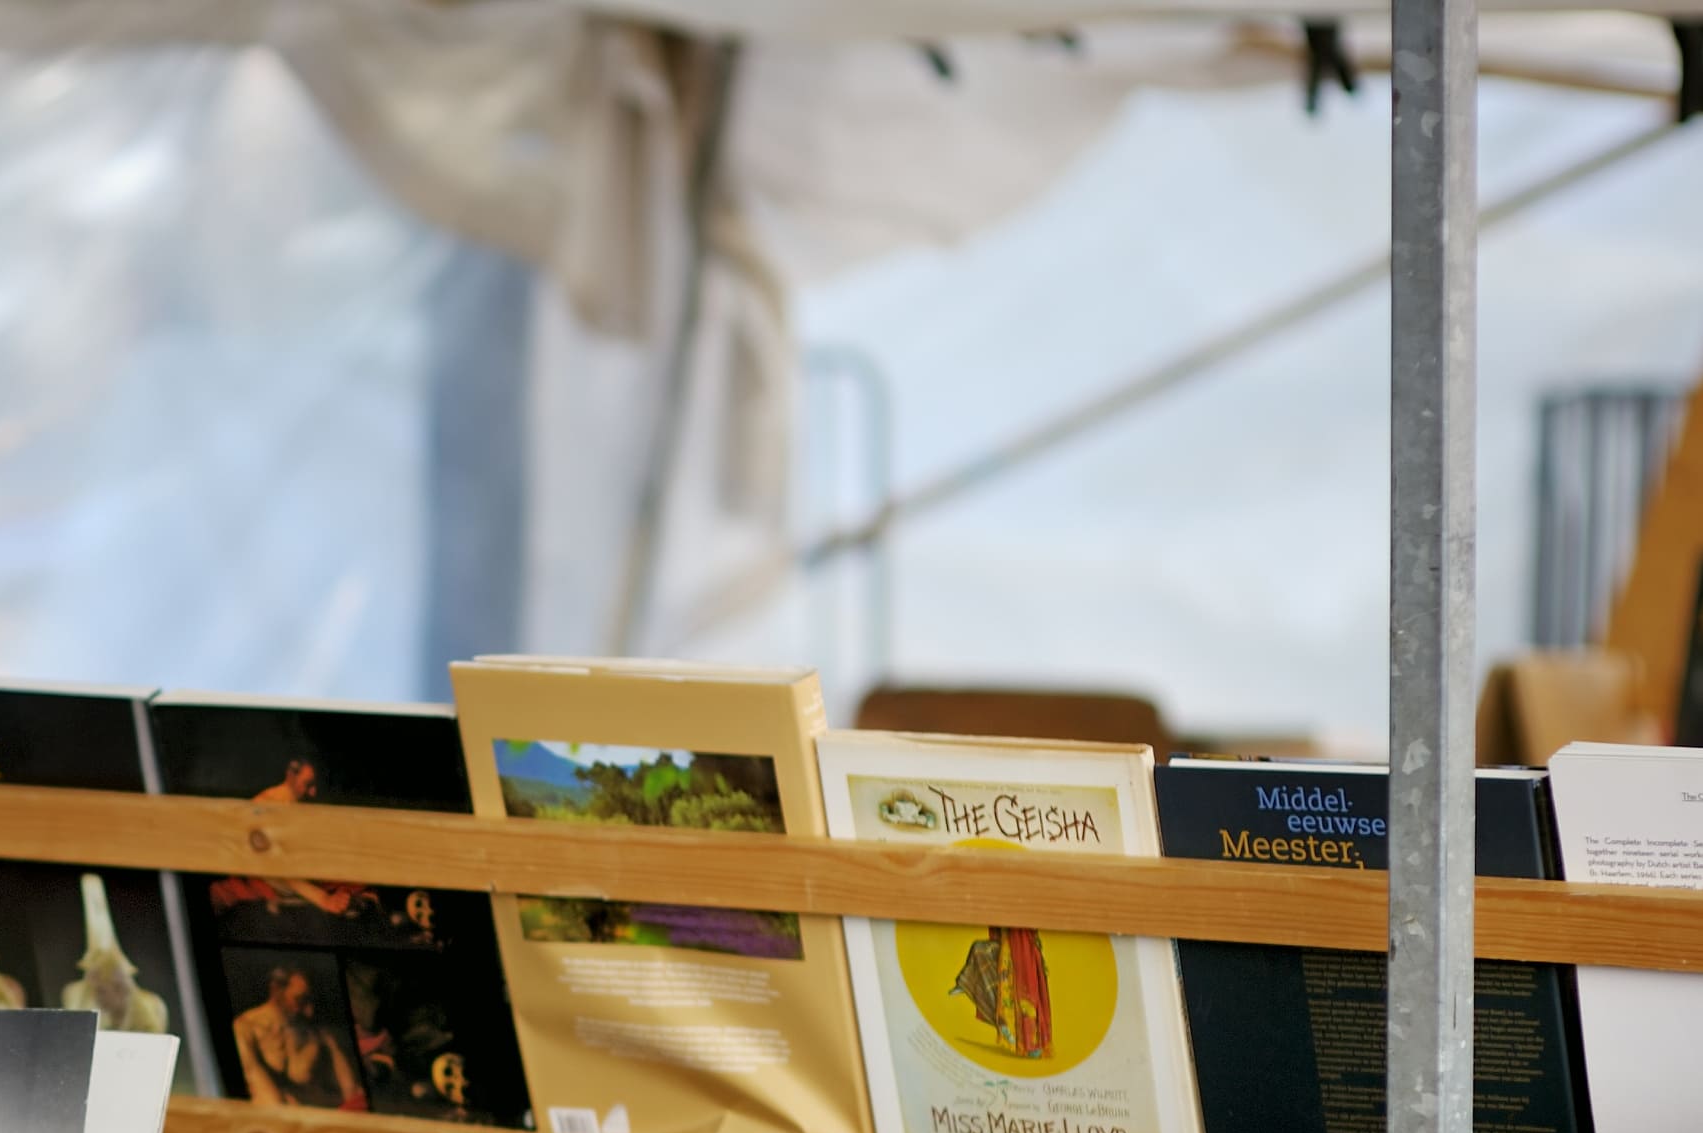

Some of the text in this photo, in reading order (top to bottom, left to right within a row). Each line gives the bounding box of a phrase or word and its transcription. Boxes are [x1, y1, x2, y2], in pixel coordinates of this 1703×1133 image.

[927, 785, 990, 837] THE
[993, 794, 1101, 844] GEISHA
[1287, 814, 1387, 836] eeuwse
